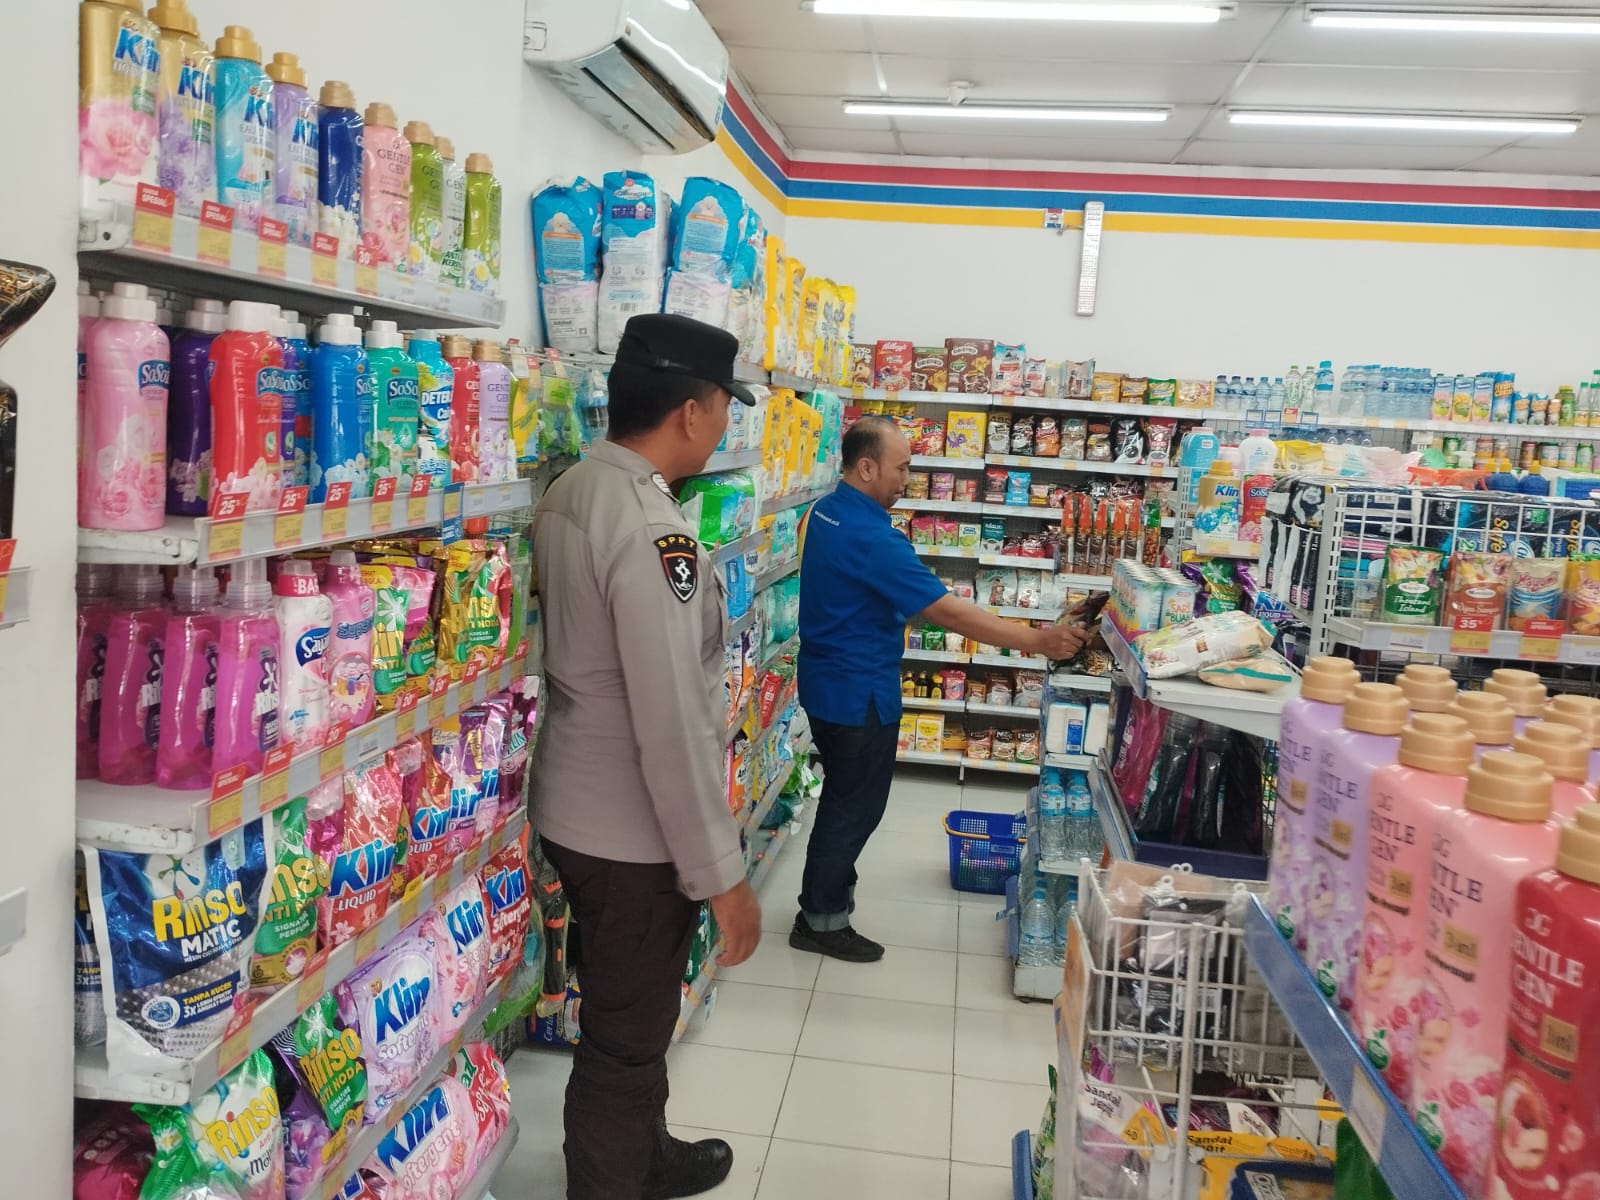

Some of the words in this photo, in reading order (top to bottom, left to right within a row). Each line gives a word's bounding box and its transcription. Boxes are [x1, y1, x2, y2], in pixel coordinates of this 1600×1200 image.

[658, 536, 696, 548] SPKT
[338, 888, 377, 912] LIQUID
[181, 918, 242, 957] MATIC
[182, 991, 210, 1005] TANPA
[375, 977, 431, 1043] Klin
[335, 1061, 364, 1092] NODA
[1085, 1083, 1122, 1107] Sandal
[206, 1086, 279, 1163] Rinso
[376, 1086, 451, 1175] Klin
[1187, 1135, 1233, 1146] Sandal
